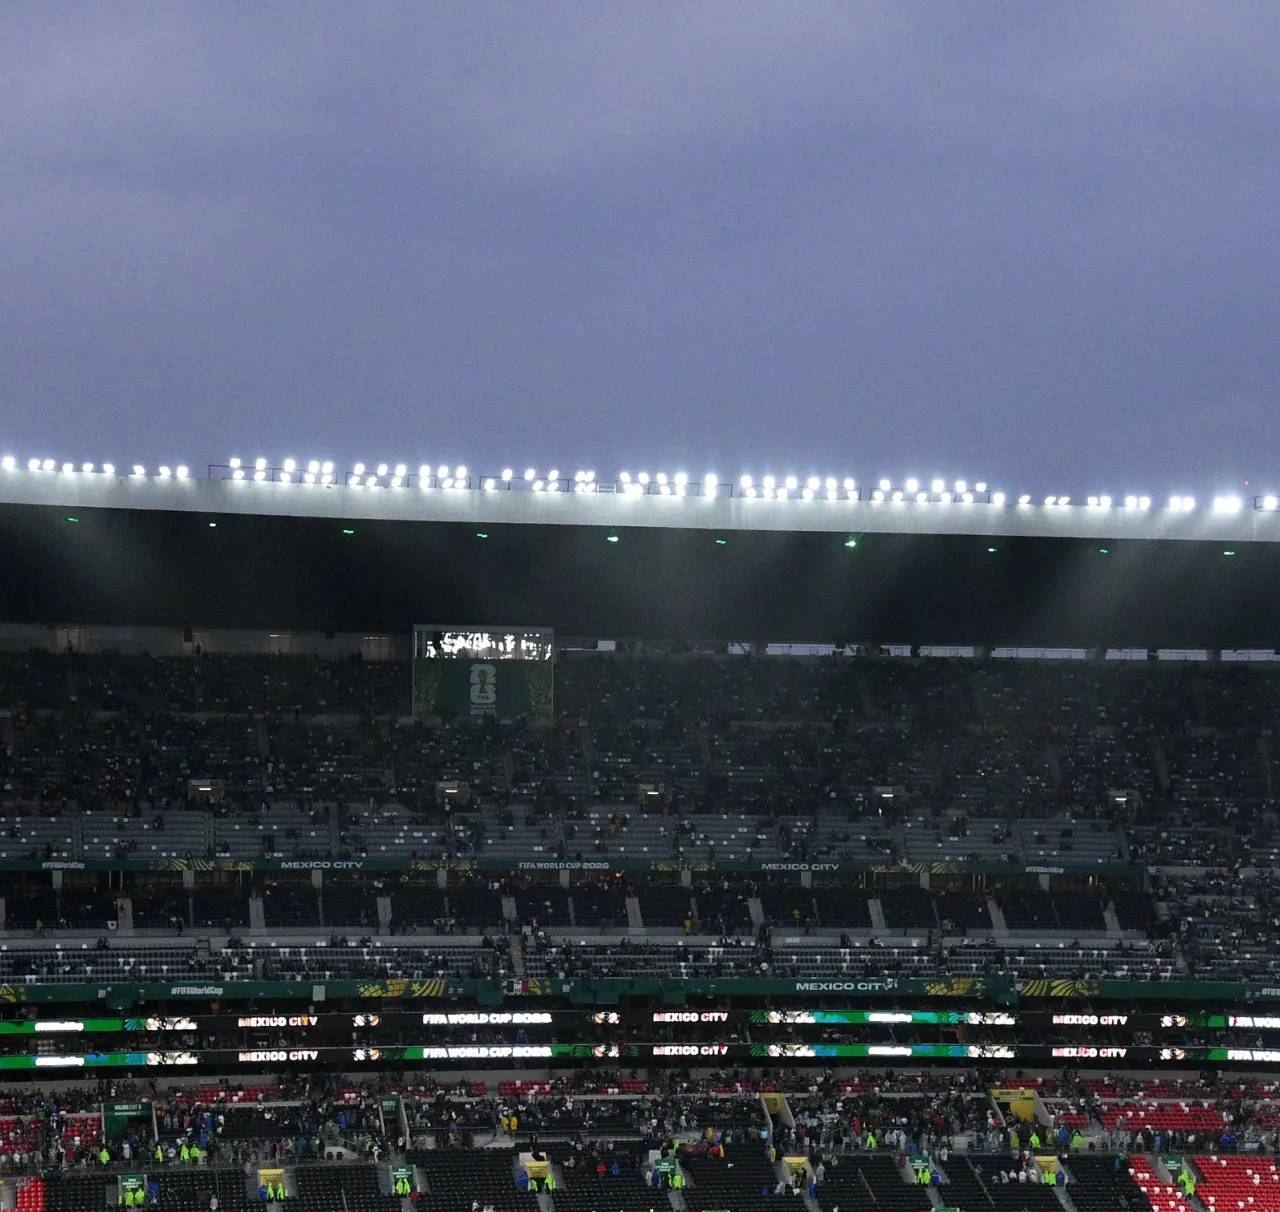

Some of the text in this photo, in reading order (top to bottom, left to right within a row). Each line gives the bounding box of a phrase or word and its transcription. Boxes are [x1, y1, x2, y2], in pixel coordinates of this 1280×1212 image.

[281, 861, 331, 869] MEXICO
[518, 862, 610, 870] FIFA WORLD CUP 2026
[761, 863, 840, 871] MEXICO CITY
[171, 986, 224, 995] #FIFAWorldCup
[796, 982, 855, 991] MEXICO
[238, 1017, 286, 1027] MEXICO
[423, 1013, 446, 1024] FIFA
[447, 1013, 488, 1024] WORLD
[489, 1013, 511, 1023] CUP
[653, 1012, 699, 1023] MEXICO
[1052, 1015, 1098, 1025] MEXICO
[1229, 1016, 1253, 1028] FIFA
[238, 1051, 286, 1061] MEXICO
[423, 1048, 446, 1058] FIFA
[447, 1048, 488, 1058] WORLD
[489, 1047, 511, 1057] CUP
[653, 1046, 699, 1056] MEXICO
[1052, 1048, 1098, 1058] MEXICO
[1228, 1050, 1252, 1060] FIFA
